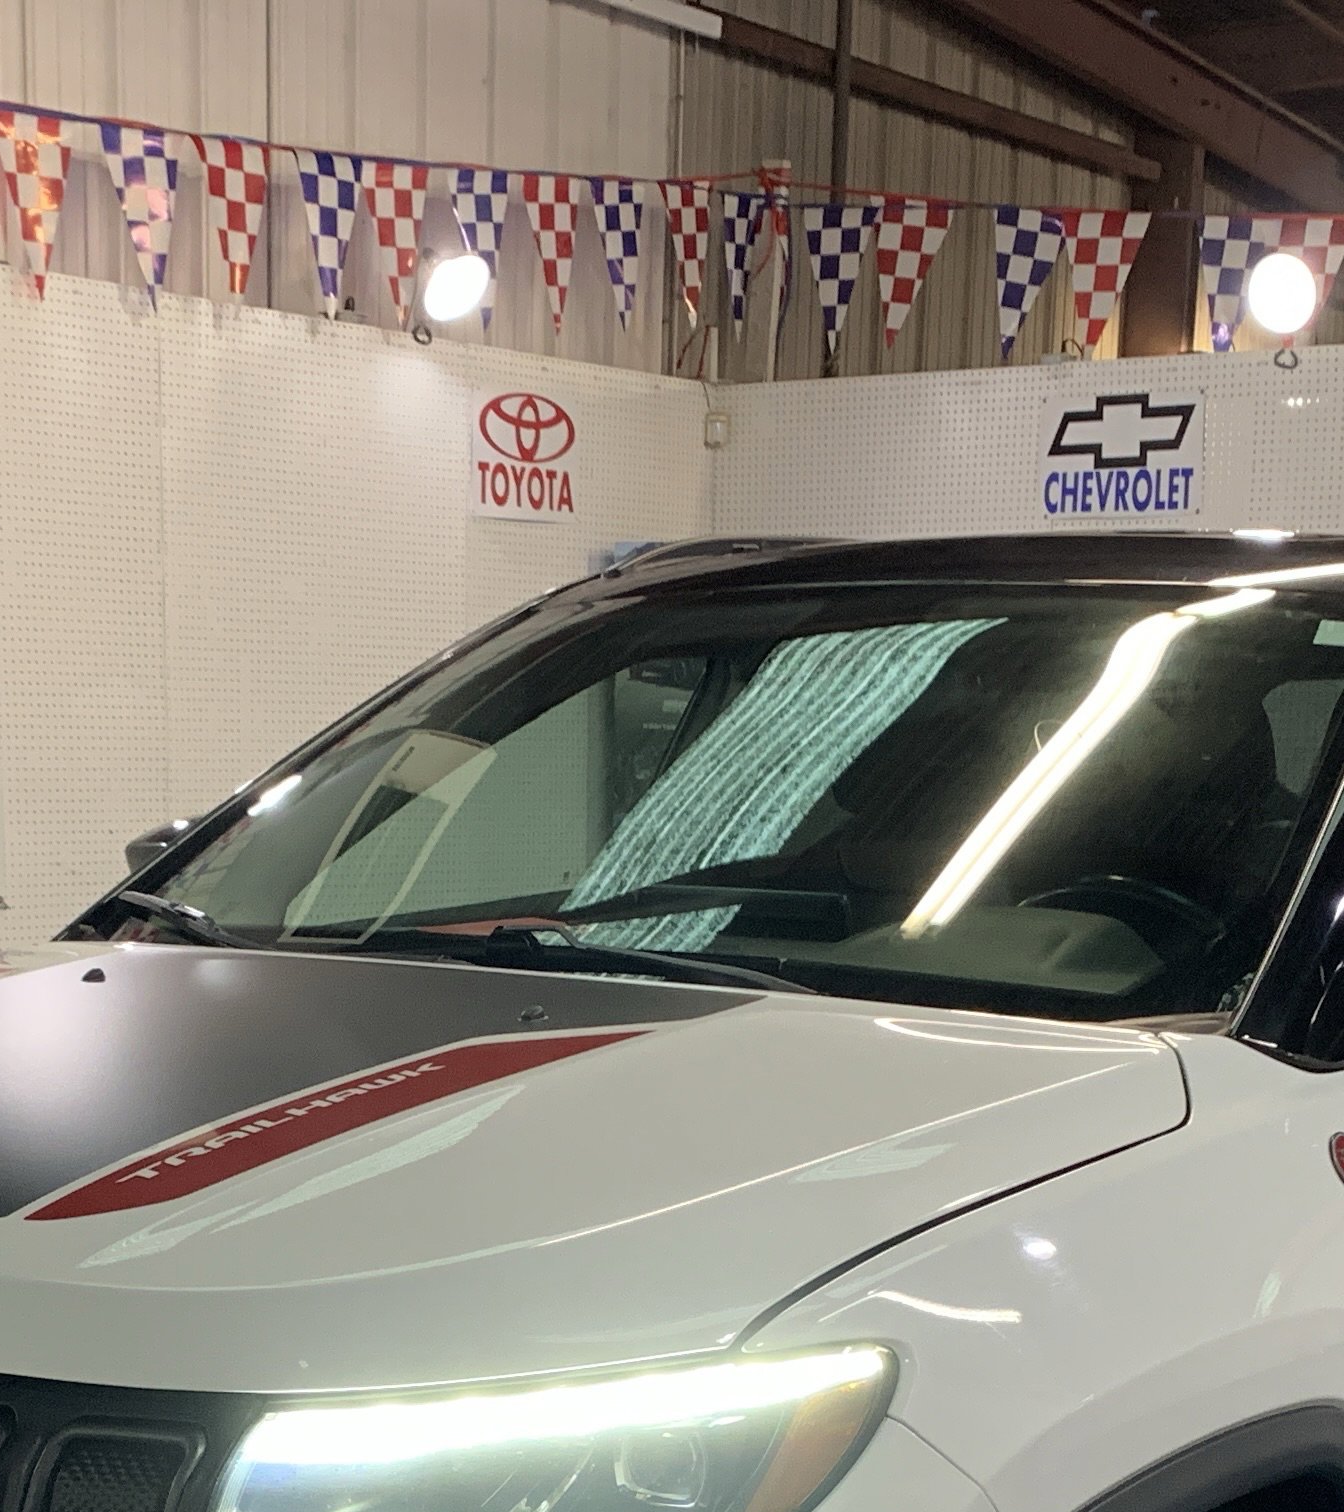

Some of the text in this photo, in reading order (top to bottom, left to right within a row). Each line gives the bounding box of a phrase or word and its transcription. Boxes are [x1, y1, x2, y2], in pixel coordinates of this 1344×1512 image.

[477, 461, 574, 514] TOYOTA
[1043, 468, 1194, 514] CHEVROLET
[114, 1062, 447, 1184] TRAILHAWK
